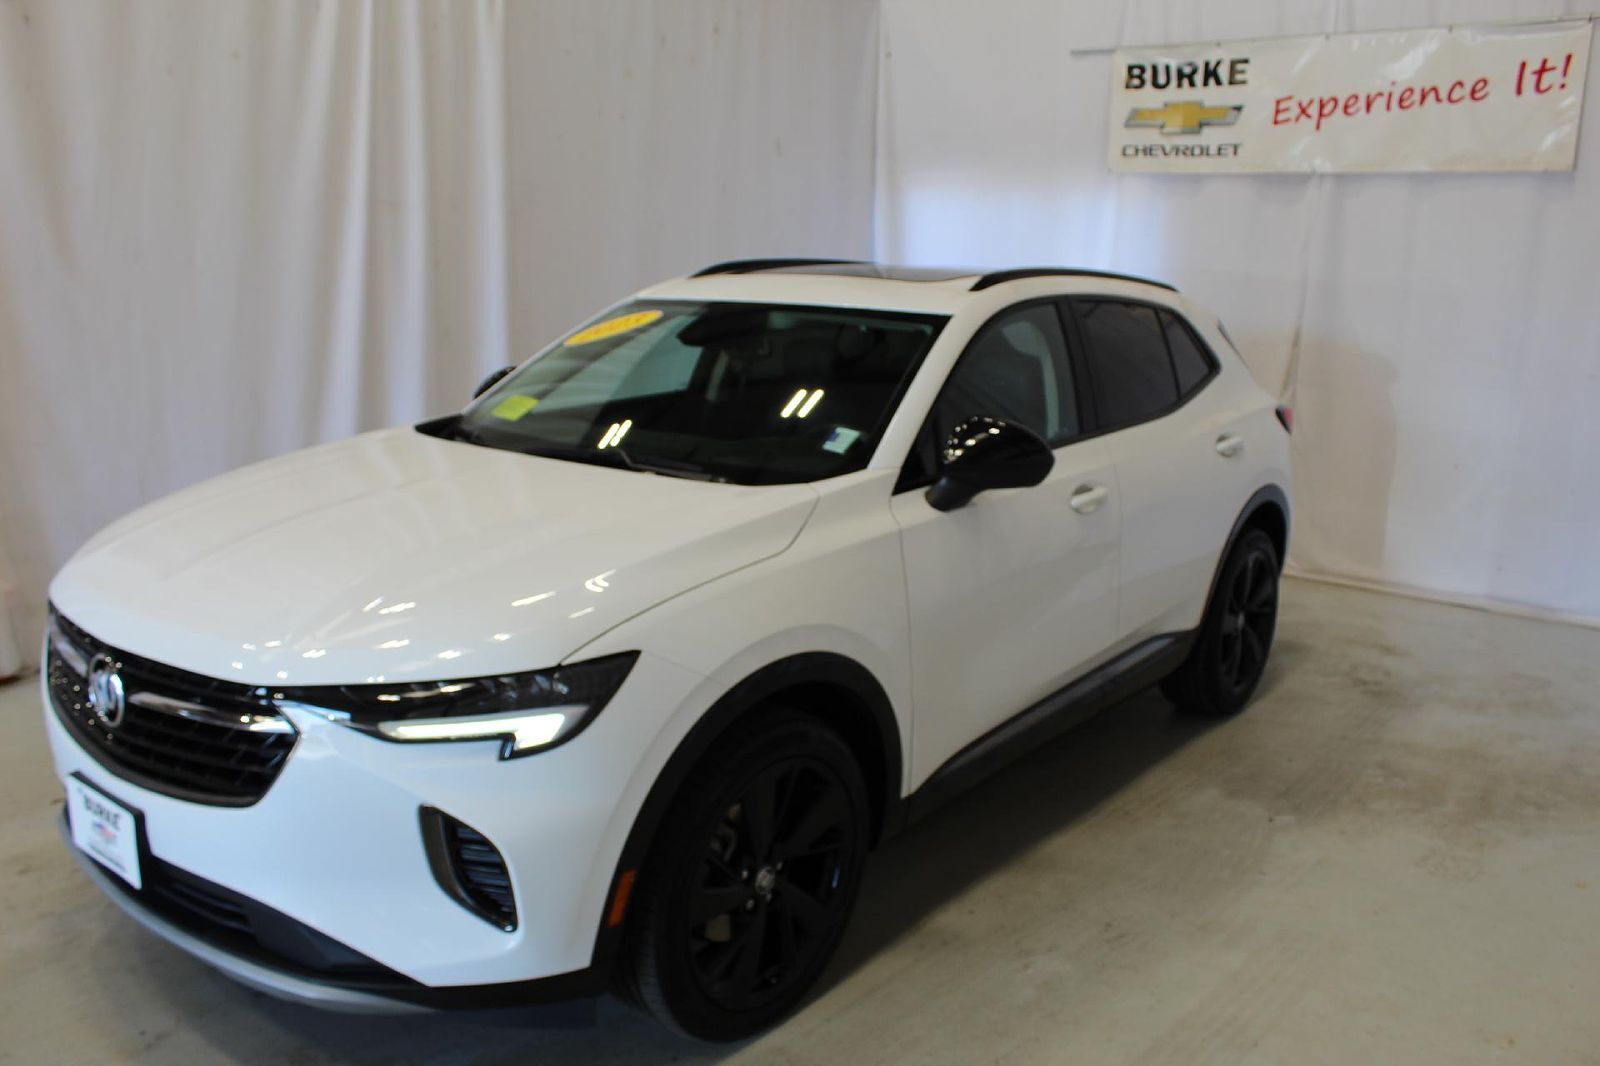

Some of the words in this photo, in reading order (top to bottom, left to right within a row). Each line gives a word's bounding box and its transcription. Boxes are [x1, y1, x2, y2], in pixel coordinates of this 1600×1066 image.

[1125, 58, 1249, 90] BURKE
[1272, 76, 1490, 131] Experience
[1515, 52, 1573, 97] It!
[1122, 143, 1241, 157] CHEVROLET
